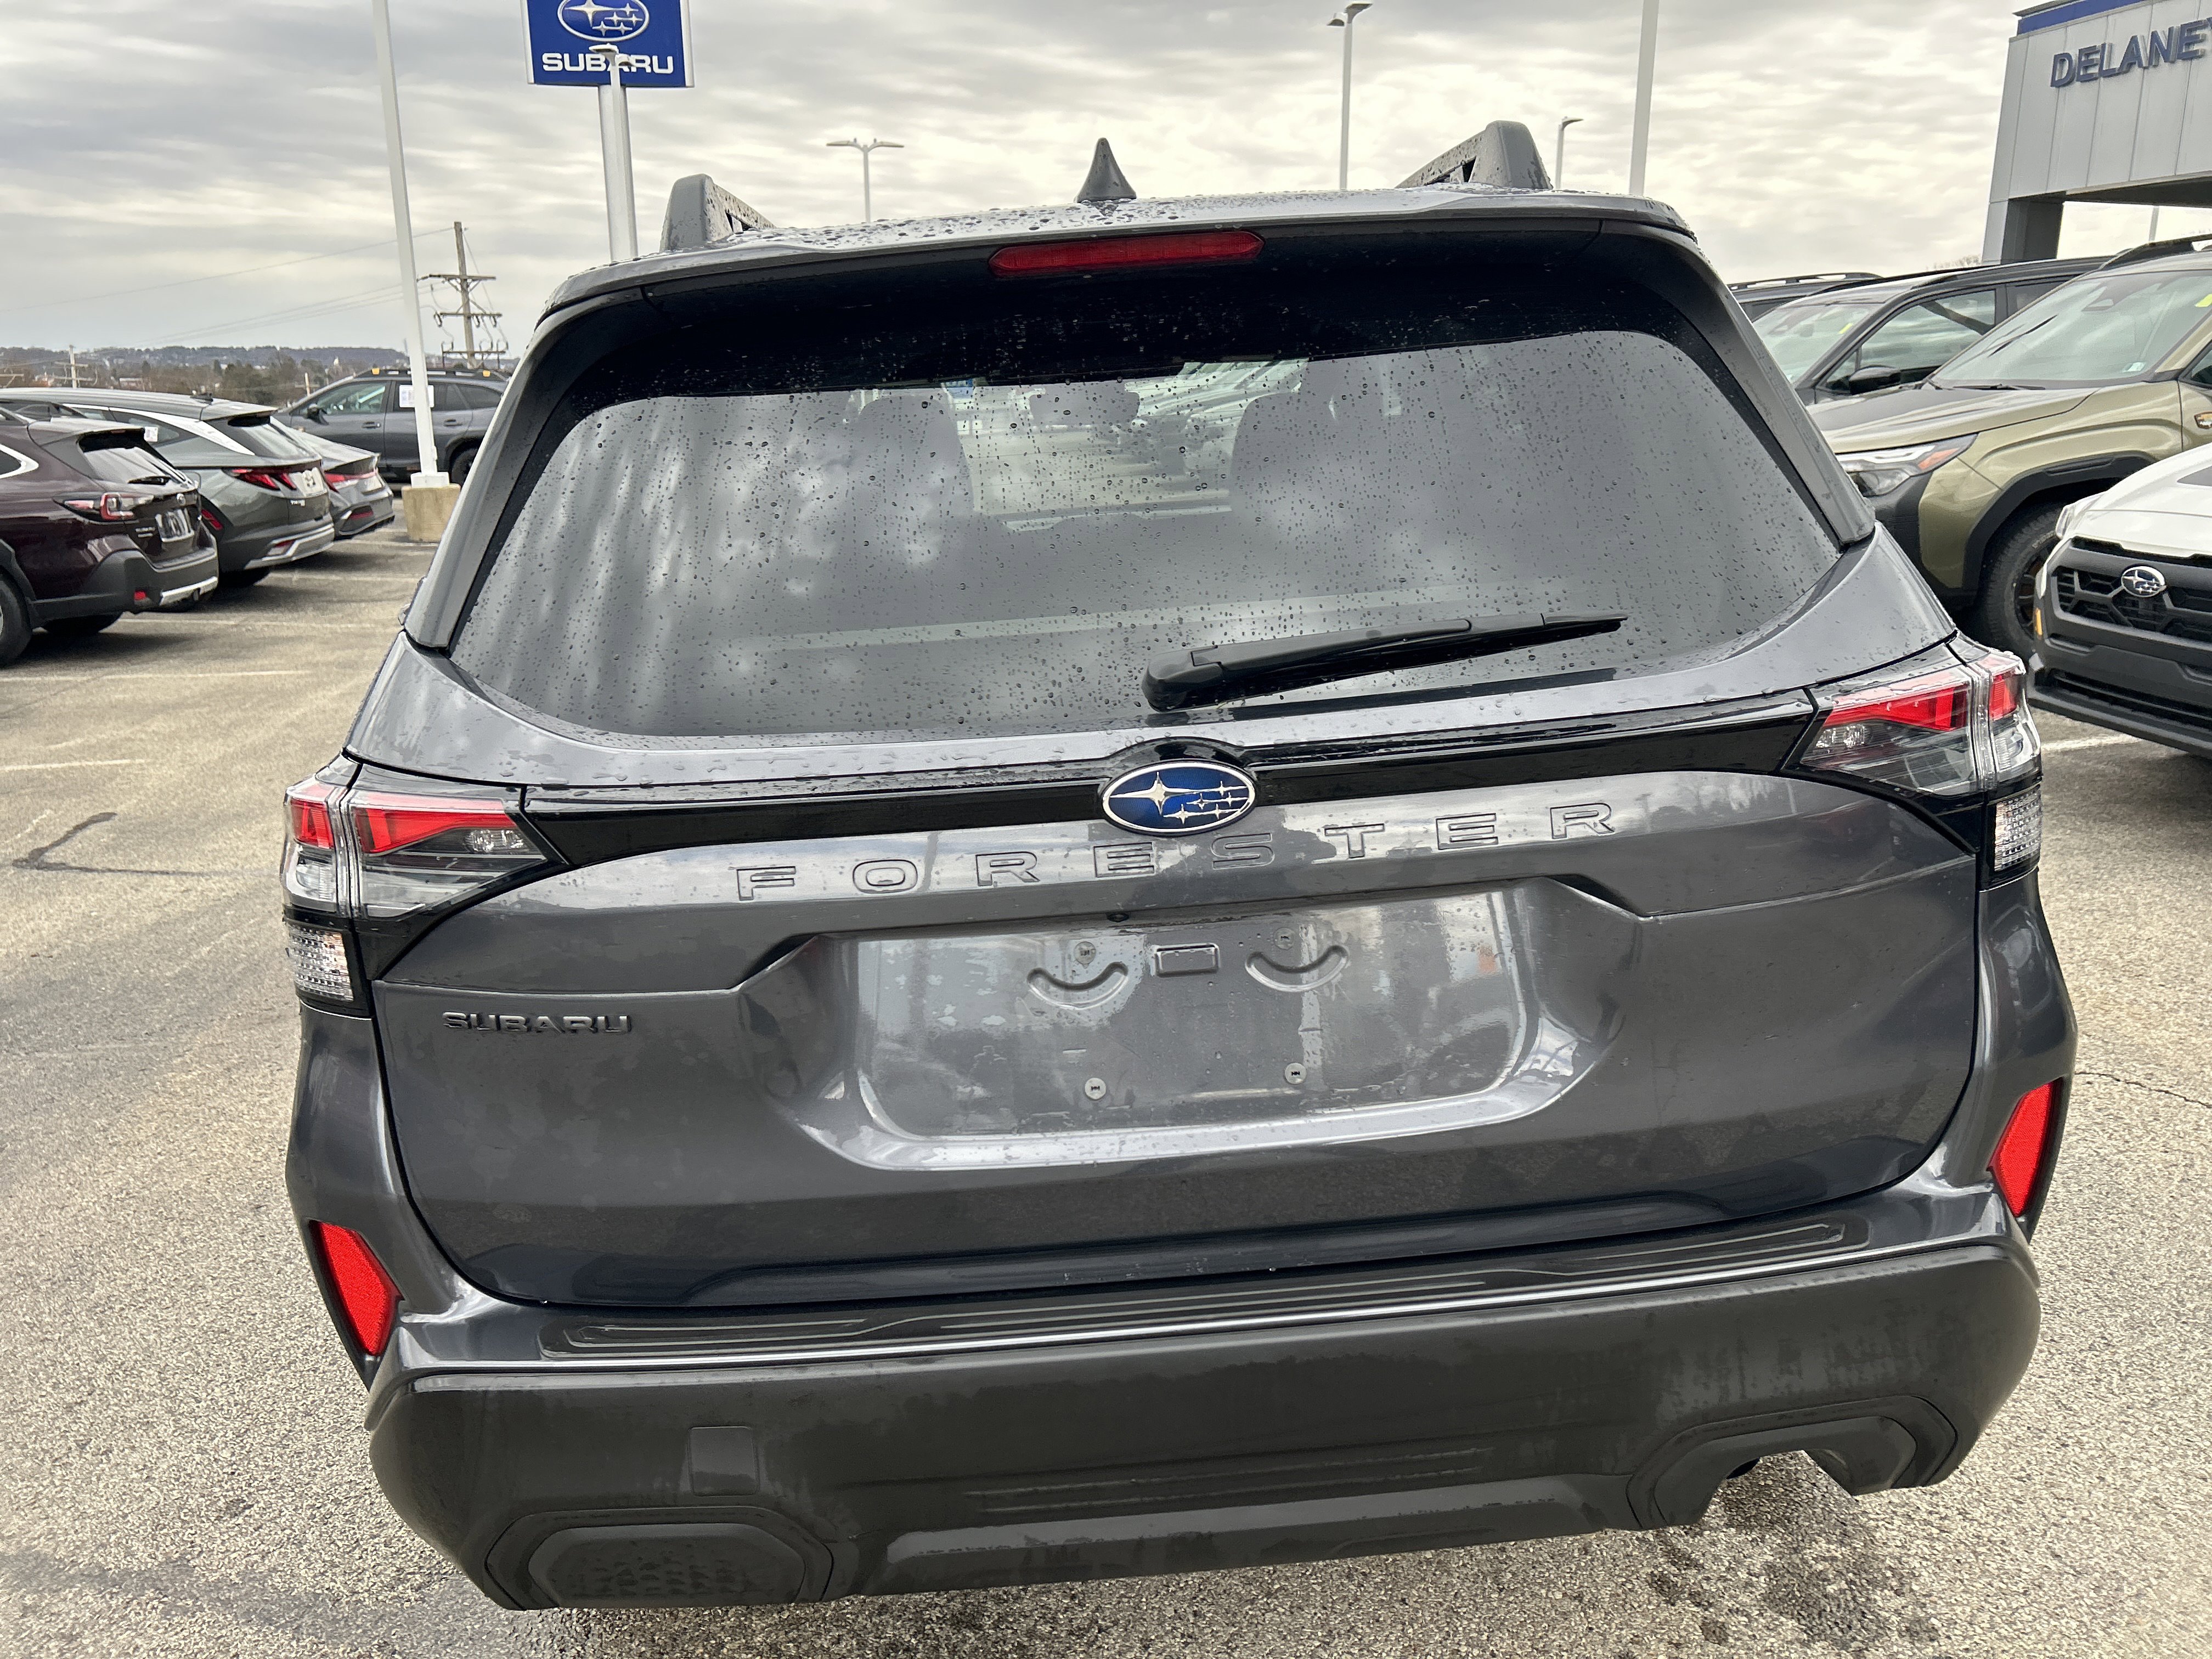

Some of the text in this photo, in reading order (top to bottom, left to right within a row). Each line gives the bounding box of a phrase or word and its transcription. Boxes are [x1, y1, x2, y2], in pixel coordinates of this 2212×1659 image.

[2050, 16, 2212, 87] DELANE
[736, 802, 1615, 901] FORESTER
[442, 1011, 631, 1034] SUBARU
